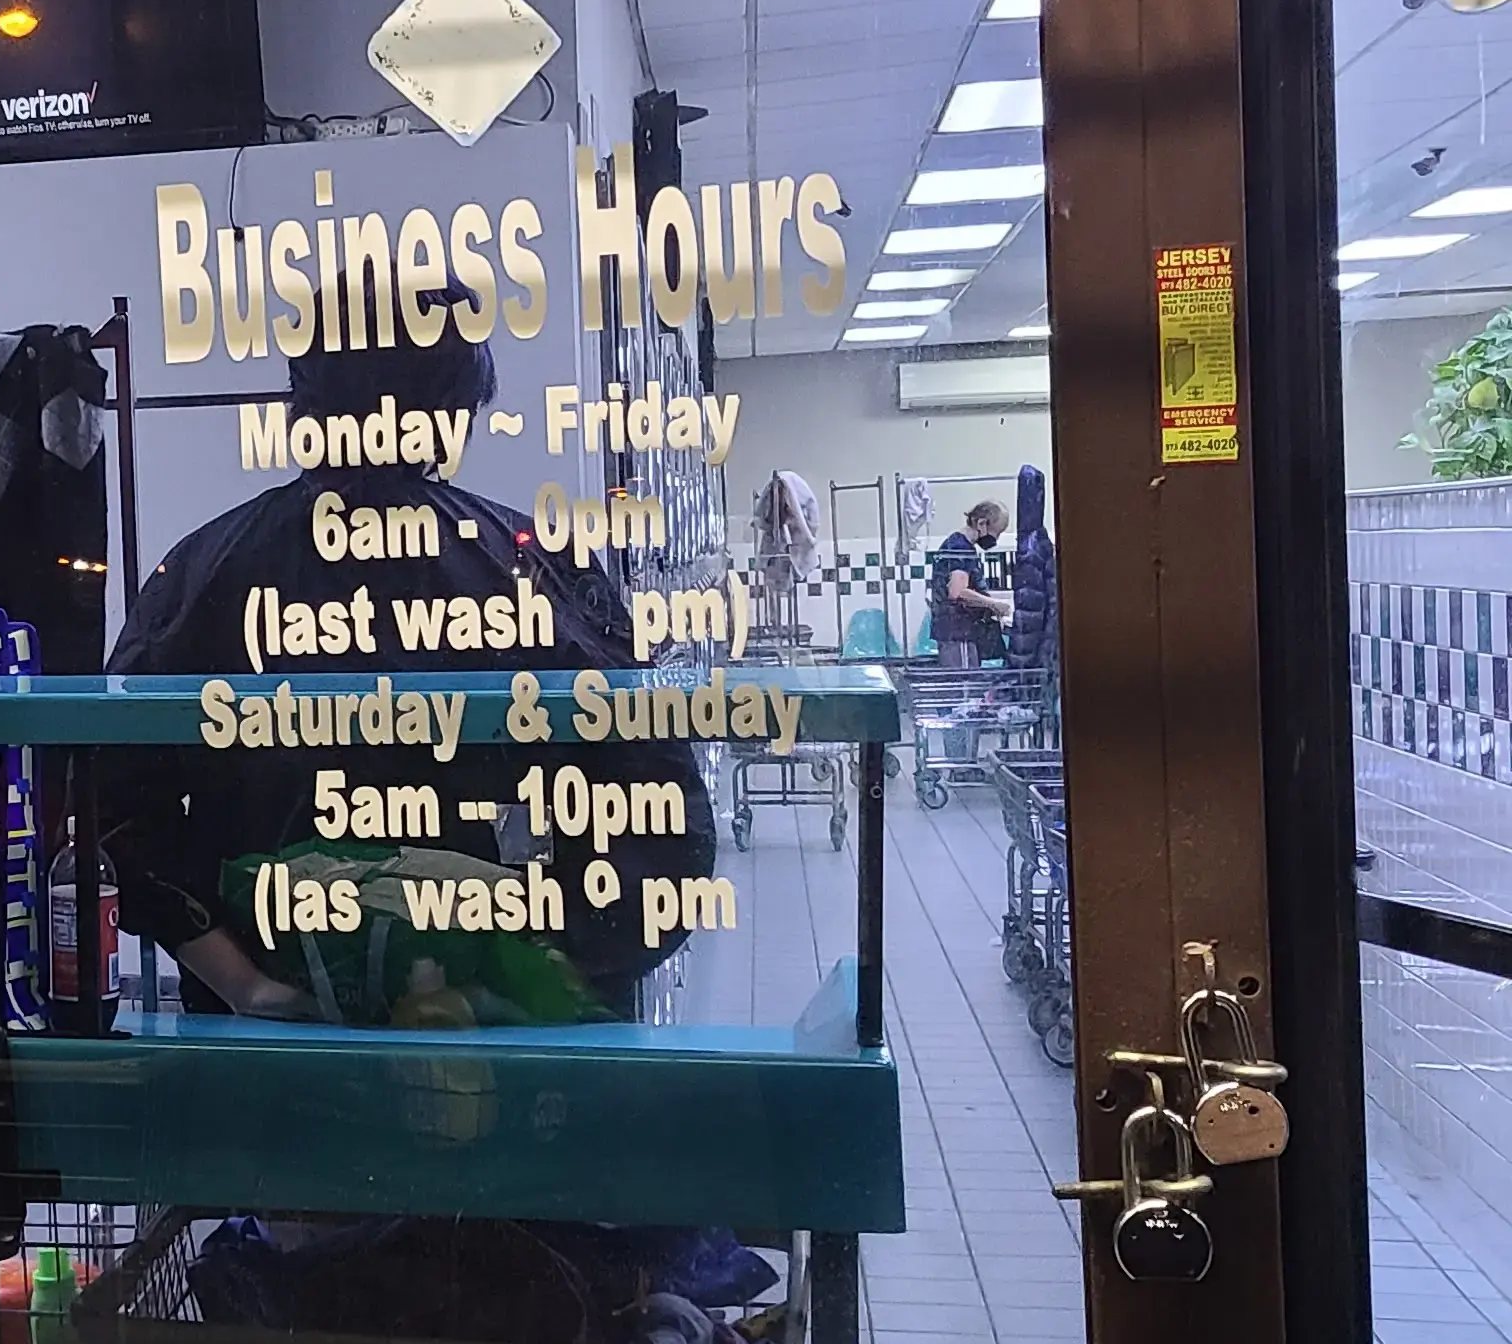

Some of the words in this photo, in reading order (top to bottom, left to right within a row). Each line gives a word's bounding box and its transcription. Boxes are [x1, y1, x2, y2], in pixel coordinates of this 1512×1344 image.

[0, 89, 89, 121] verizon
[95, 117, 109, 127] turn
[110, 116, 126, 128] your
[127, 114, 138, 124] TV
[157, 171, 545, 362] Business
[576, 141, 850, 333] Hours
[1156, 247, 1231, 266] JERSEY
[1156, 268, 1183, 278] STEEL
[1186, 266, 1215, 277] DOORS
[1175, 276, 1232, 290] 482-4020
[1162, 305, 1185, 316] BUY
[1189, 303, 1231, 314] DIRECT
[1164, 408, 1235, 419] EMERGENCY
[1174, 417, 1224, 426] SERVICE
[241, 396, 468, 478] Monday
[547, 382, 738, 465] Friday
[1180, 439, 1235, 452] 482-4020
[313, 492, 438, 561] 6am
[244, 585, 375, 671] (last
[394, 579, 554, 650] wash
[634, 579, 748, 659] pm)
[202, 678, 463, 761] Saturday
[509, 673, 548, 742] &
[576, 670, 799, 752] Sunday
[315, 770, 440, 838] 5am
[518, 766, 684, 851] 10pm
[254, 864, 361, 950] (las
[404, 863, 564, 931] wash
[642, 876, 736, 948] pm
